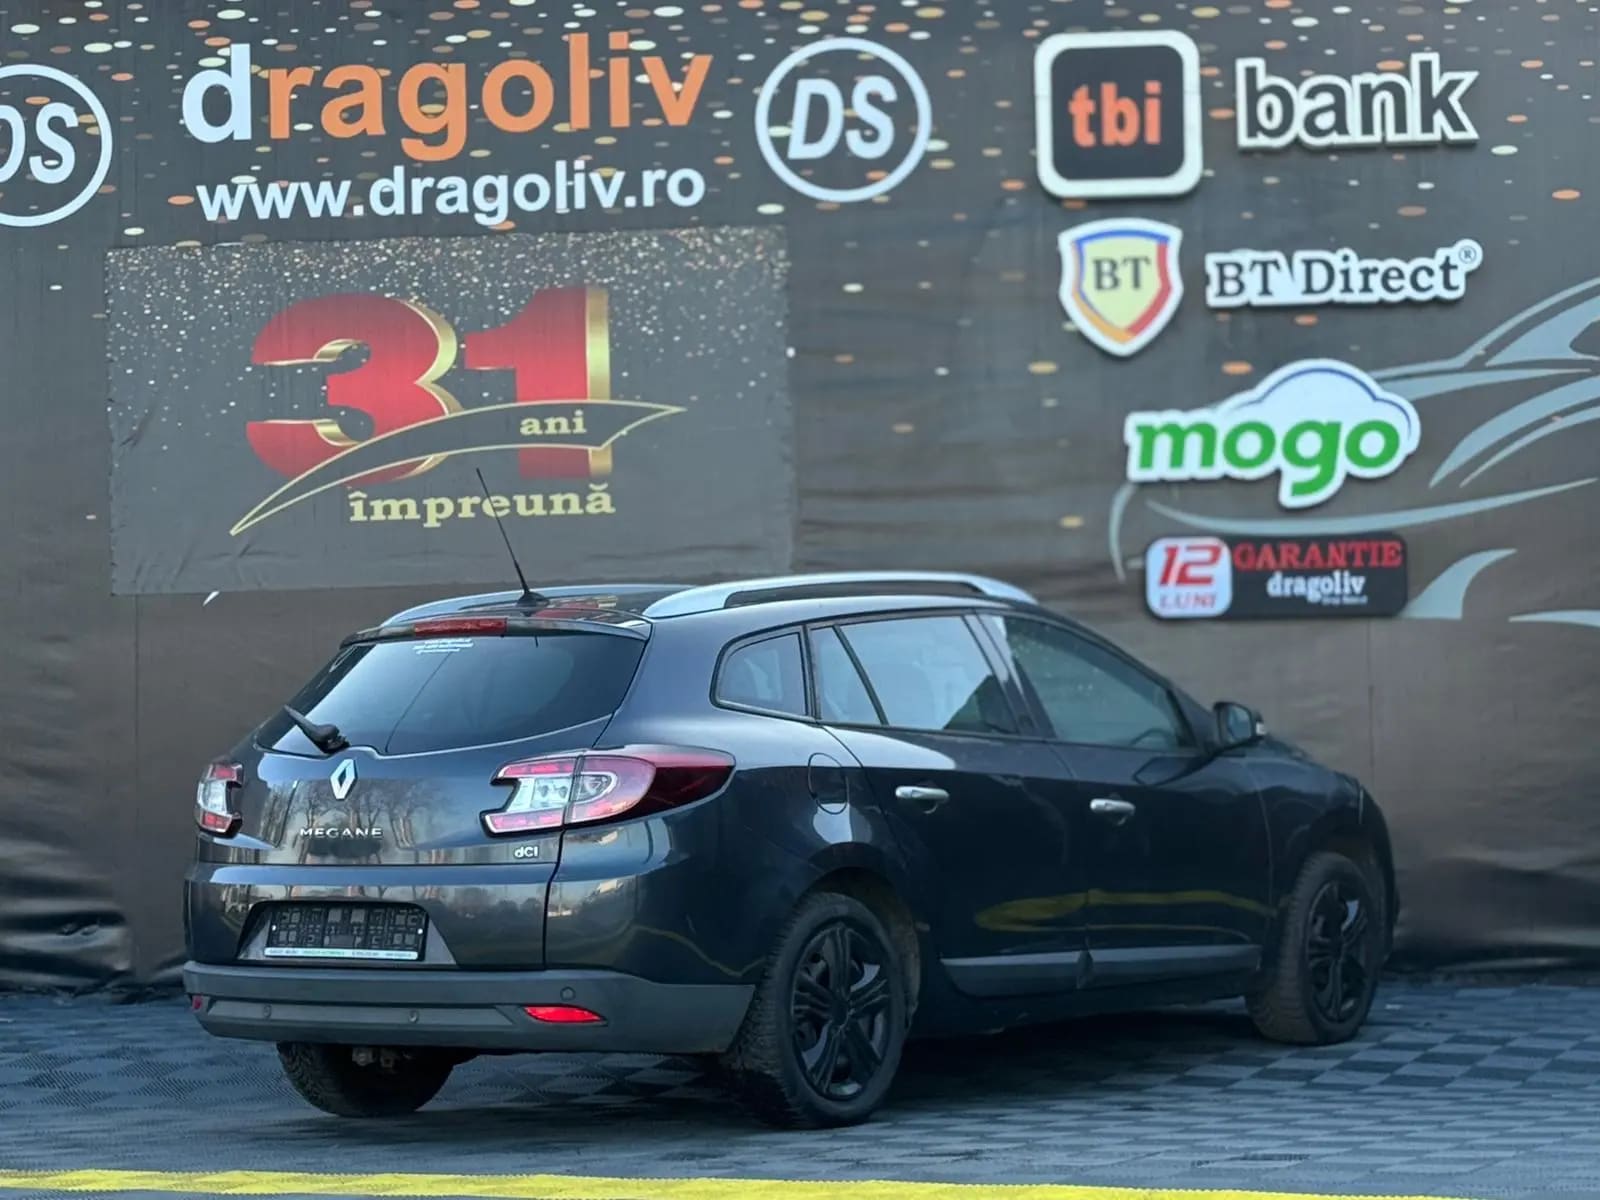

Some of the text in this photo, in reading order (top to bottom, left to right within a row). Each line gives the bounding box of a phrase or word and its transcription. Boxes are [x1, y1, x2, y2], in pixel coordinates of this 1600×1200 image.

[182, 32, 713, 161] dragoliv
[787, 75, 898, 160] DS
[1069, 54, 1479, 148] tbi bank
[196, 160, 706, 226] www.dragoliv.ro
[1092, 256, 1152, 292] BT
[1215, 258, 1281, 297] BT
[245, 286, 613, 483] 31
[520, 409, 587, 436] ani
[1136, 419, 1401, 497] mogo
[348, 483, 617, 528] împreună
[1158, 544, 1223, 587] 12
[1232, 540, 1403, 571] GARANTIE
[1159, 592, 1217, 610] LUNI
[1266, 570, 1366, 603] dragoliv
[299, 826, 384, 839] MEGANE
